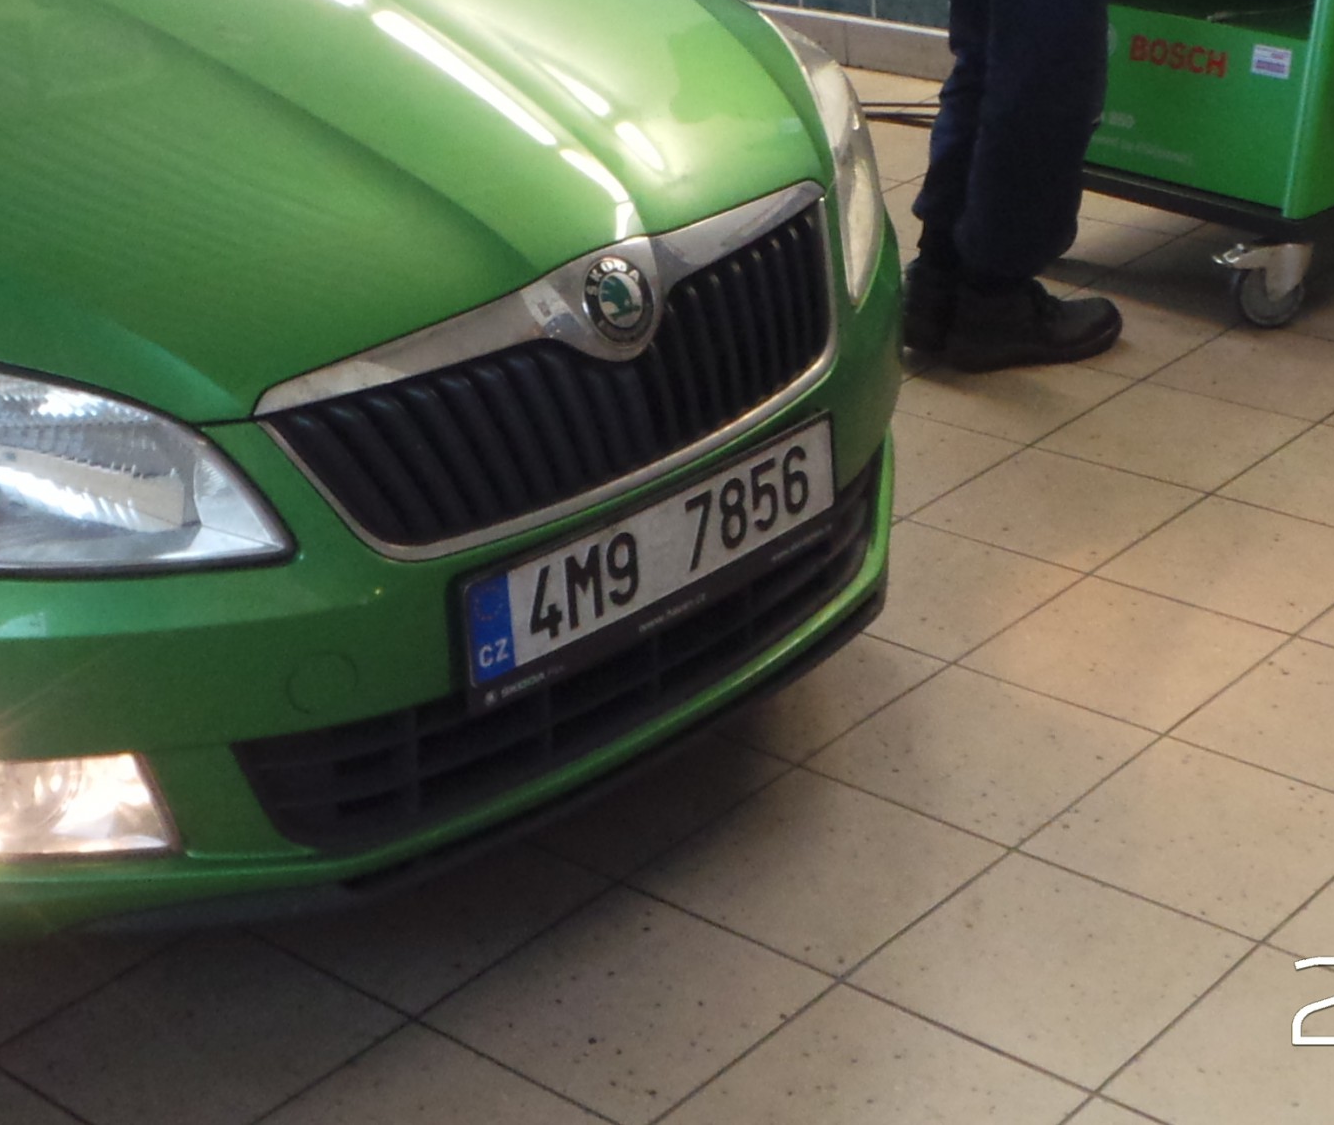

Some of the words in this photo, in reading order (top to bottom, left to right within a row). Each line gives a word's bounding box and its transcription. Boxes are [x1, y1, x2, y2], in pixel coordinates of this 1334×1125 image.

[1129, 34, 1228, 79] BOSCH
[529, 531, 639, 640] 4M9
[684, 445, 810, 573] 7856
[478, 638, 510, 668] CZ
